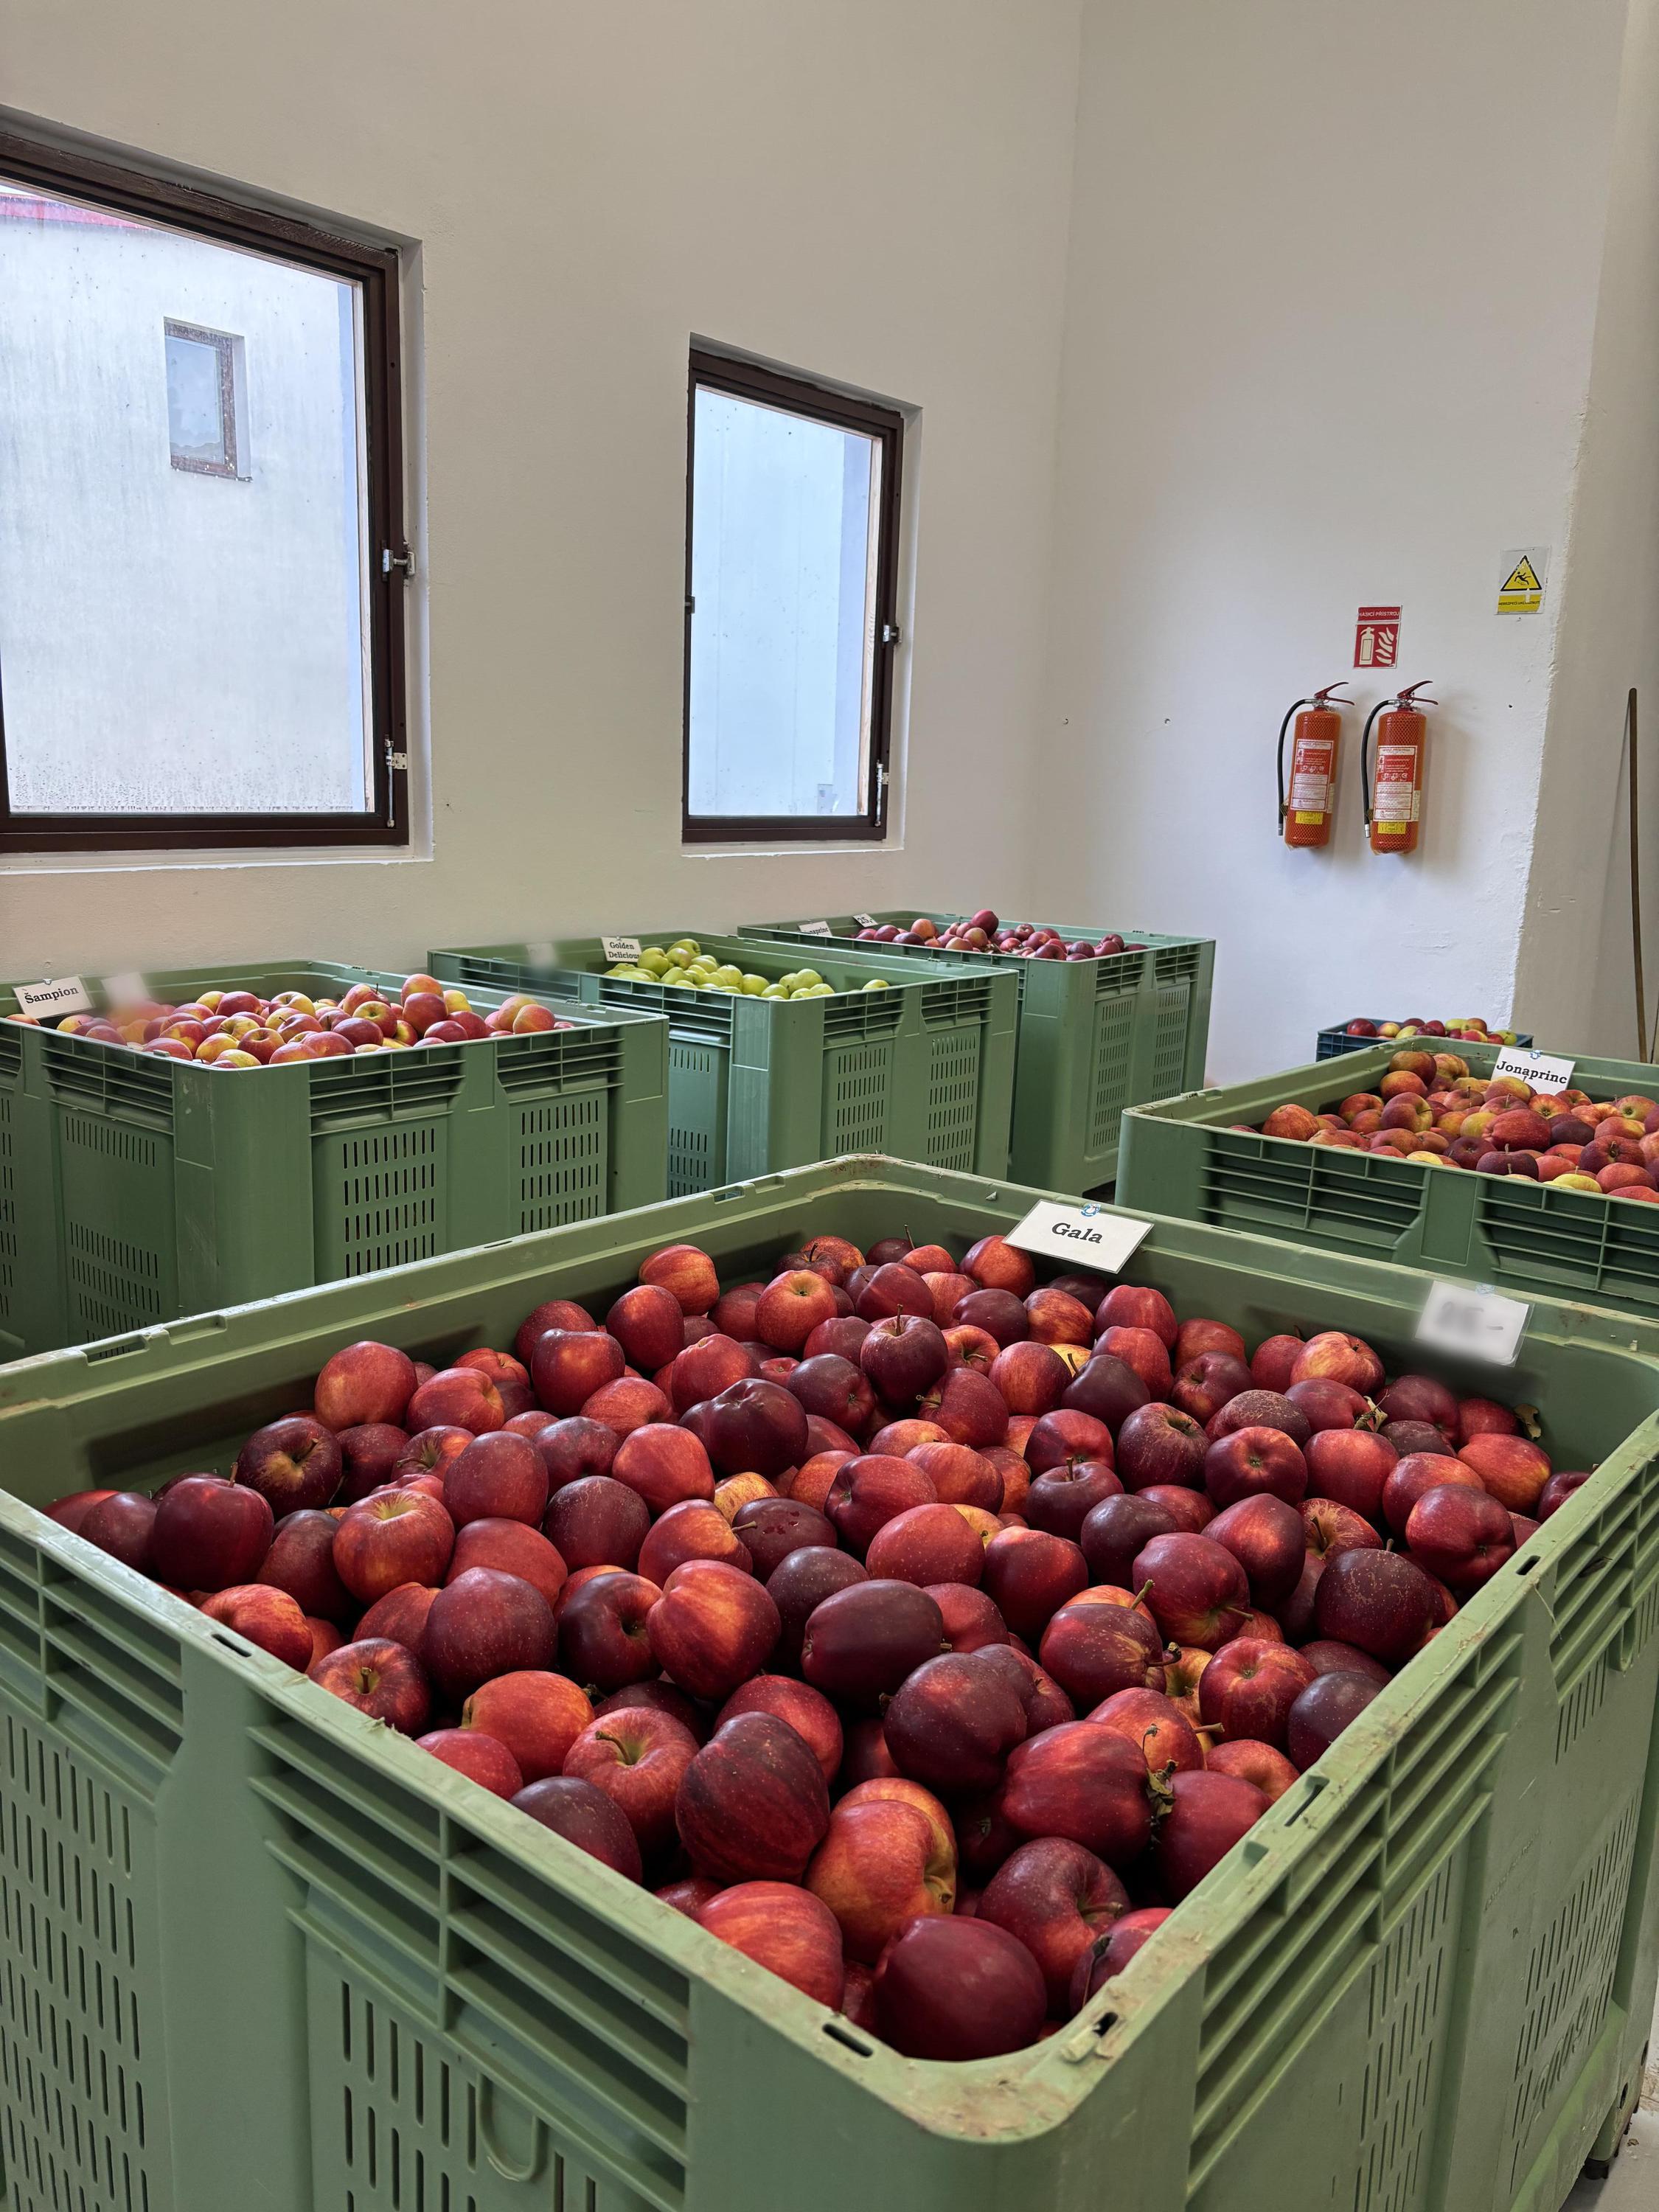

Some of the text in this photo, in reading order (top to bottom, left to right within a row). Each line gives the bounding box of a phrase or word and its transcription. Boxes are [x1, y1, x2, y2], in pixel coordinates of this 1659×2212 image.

[24, 987, 79, 1004] Šampion
[1496, 1060, 1568, 1084] Jonaprinc
[1051, 1222, 1103, 1244] Gala
